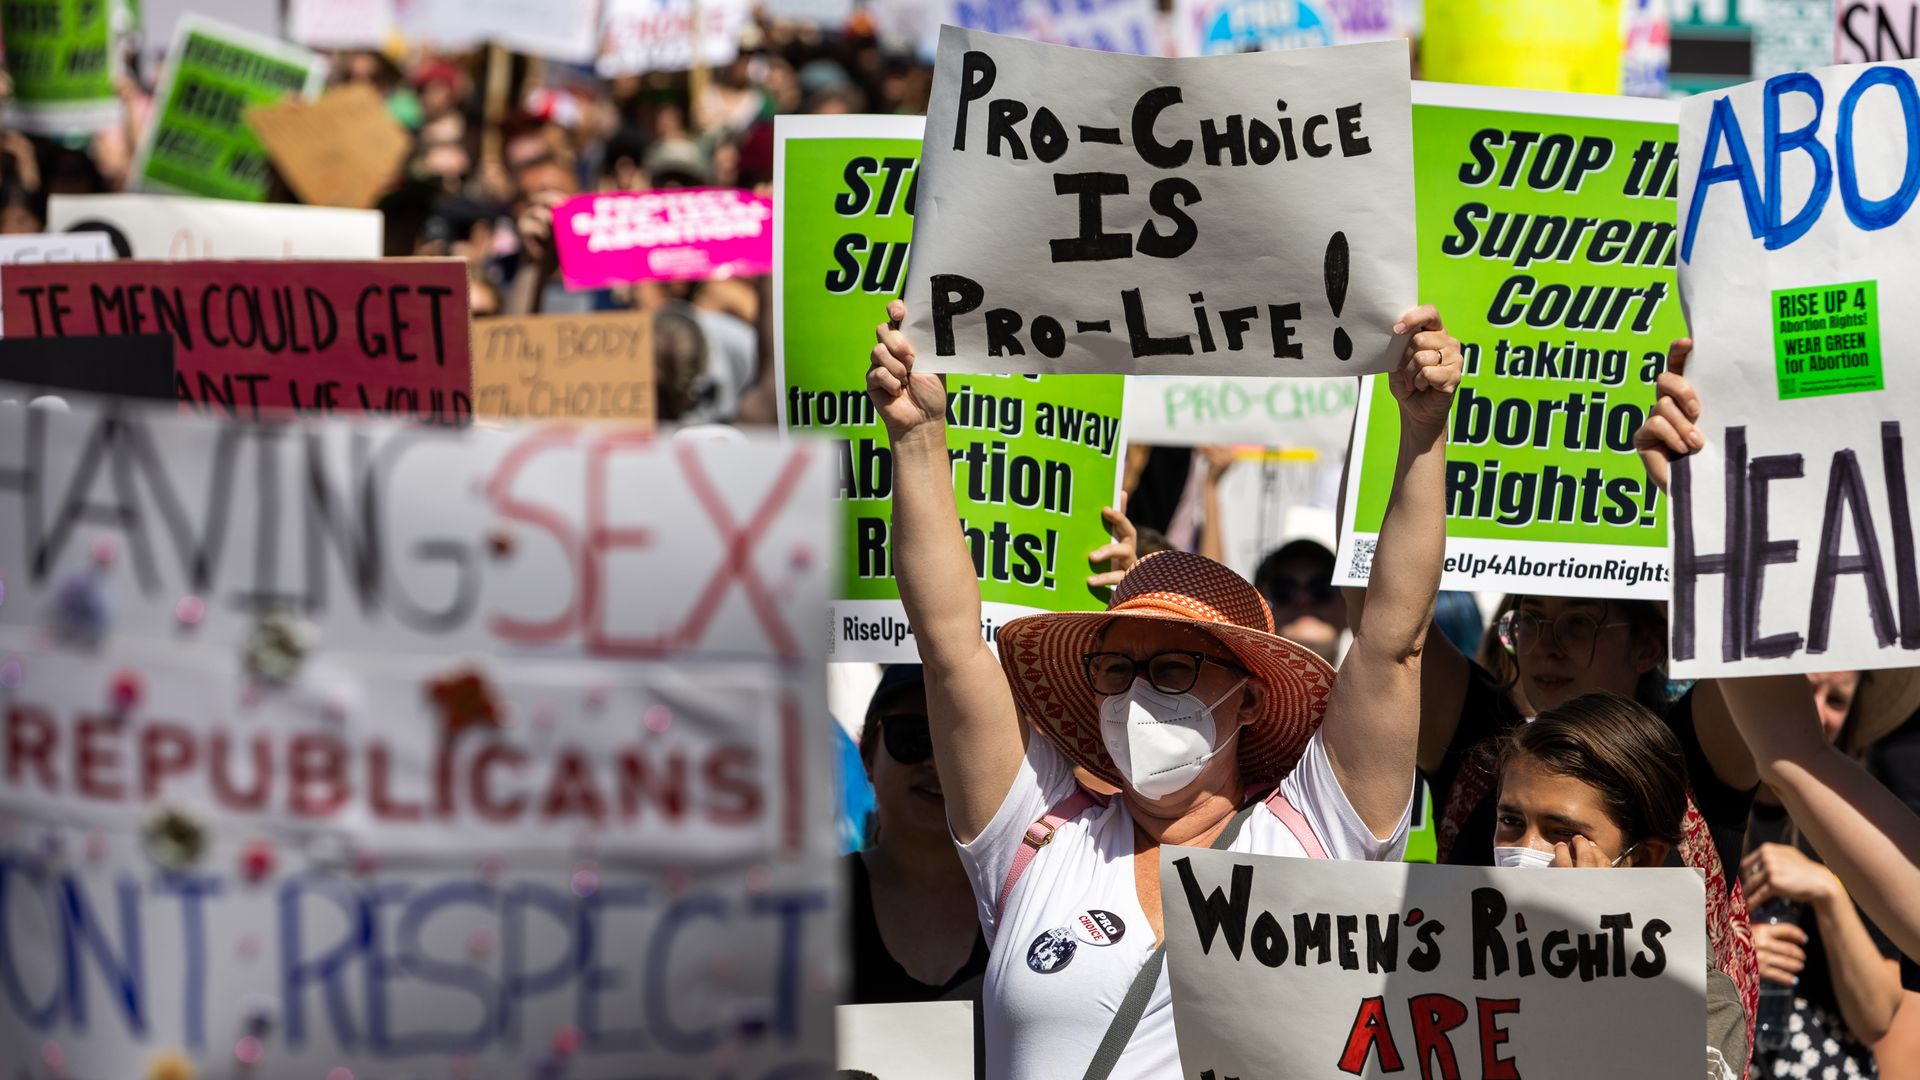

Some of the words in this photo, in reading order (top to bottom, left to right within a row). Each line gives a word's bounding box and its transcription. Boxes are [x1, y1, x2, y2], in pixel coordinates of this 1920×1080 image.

[1457, 128, 1615, 194] STOP
[1049, 171, 1202, 263] IS
[824, 232, 910, 299] Su
[89, 284, 194, 351] MEN
[201, 283, 339, 355] COULD
[356, 284, 453, 366] GET
[1486, 274, 1668, 335] Court
[1779, 292, 1819, 319] RISE
[1824, 289, 1848, 314] UP
[1853, 287, 1867, 311] 4
[1780, 317, 1827, 334] Abortion
[1829, 312, 1869, 330] Rights!
[557, 321, 647, 368] BODY
[1494, 339, 1630, 387] taking
[1784, 336, 1822, 356] WEAR
[1825, 332, 1867, 352] GREEN
[1785, 357, 1805, 374] for
[1809, 351, 1870, 372] Abortion
[527, 381, 652, 418] CHOICE
[789, 385, 876, 428] from
[1034, 400, 1119, 458] away
[1446, 387, 1656, 452] bortio
[832, 437, 1073, 517] Abrtion
[1446, 459, 1661, 529] Rights!
[483, 422, 817, 663] SEX
[857, 516, 1059, 591] Rhts!
[1078, 915, 1104, 942] CHOICE
[1094, 912, 1118, 935] PRO
[1172, 857, 1445, 974] WOMEN'S
[278, 870, 830, 1062] RESPECT
[1337, 993, 1522, 1080] ARE
